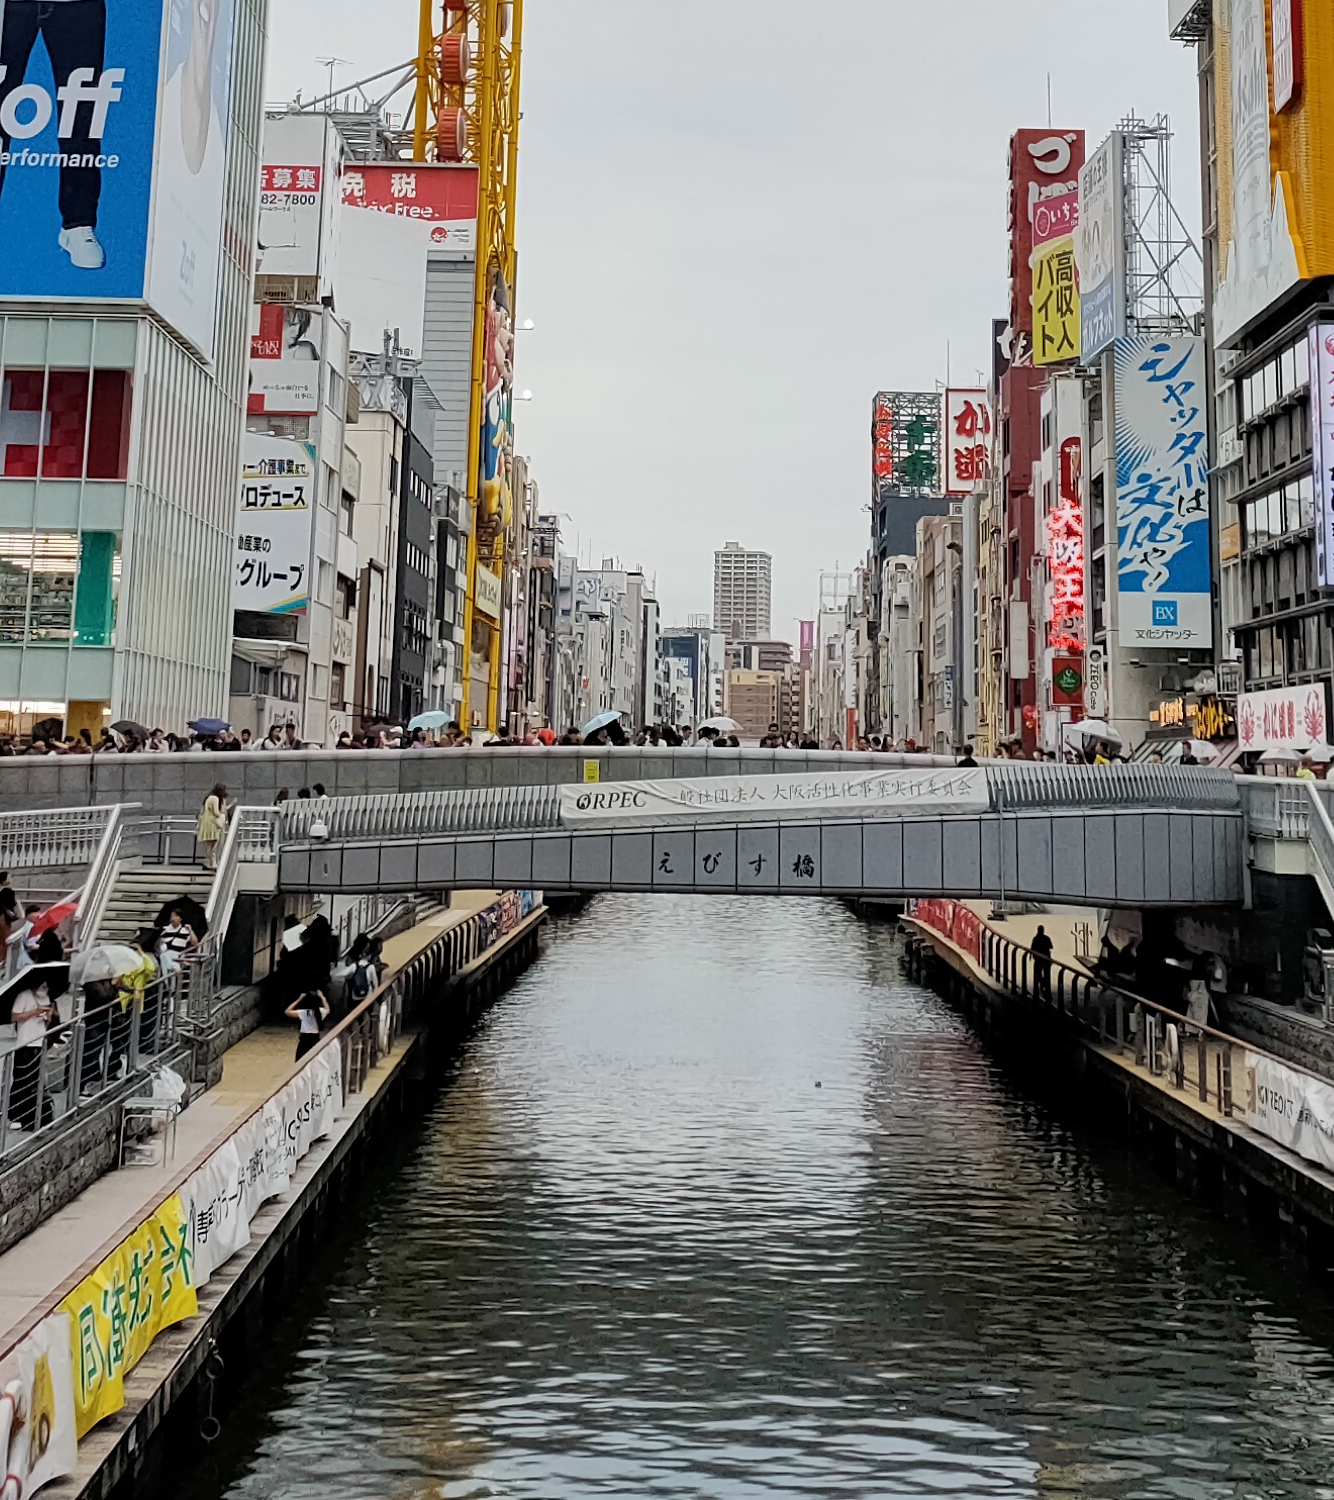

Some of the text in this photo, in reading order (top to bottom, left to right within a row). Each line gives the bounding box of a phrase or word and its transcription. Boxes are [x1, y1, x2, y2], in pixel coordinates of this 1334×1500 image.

[0, 148, 121, 171] erformance
[342, 171, 417, 199] 免税
[1036, 255, 1056, 358] バイト
[243, 459, 307, 476] ー介護事業まで
[236, 558, 305, 593] グループ
[1155, 605, 1175, 622] BX
[1135, 628, 1199, 641] 文化シャッター
[659, 851, 815, 879] えびす橋
